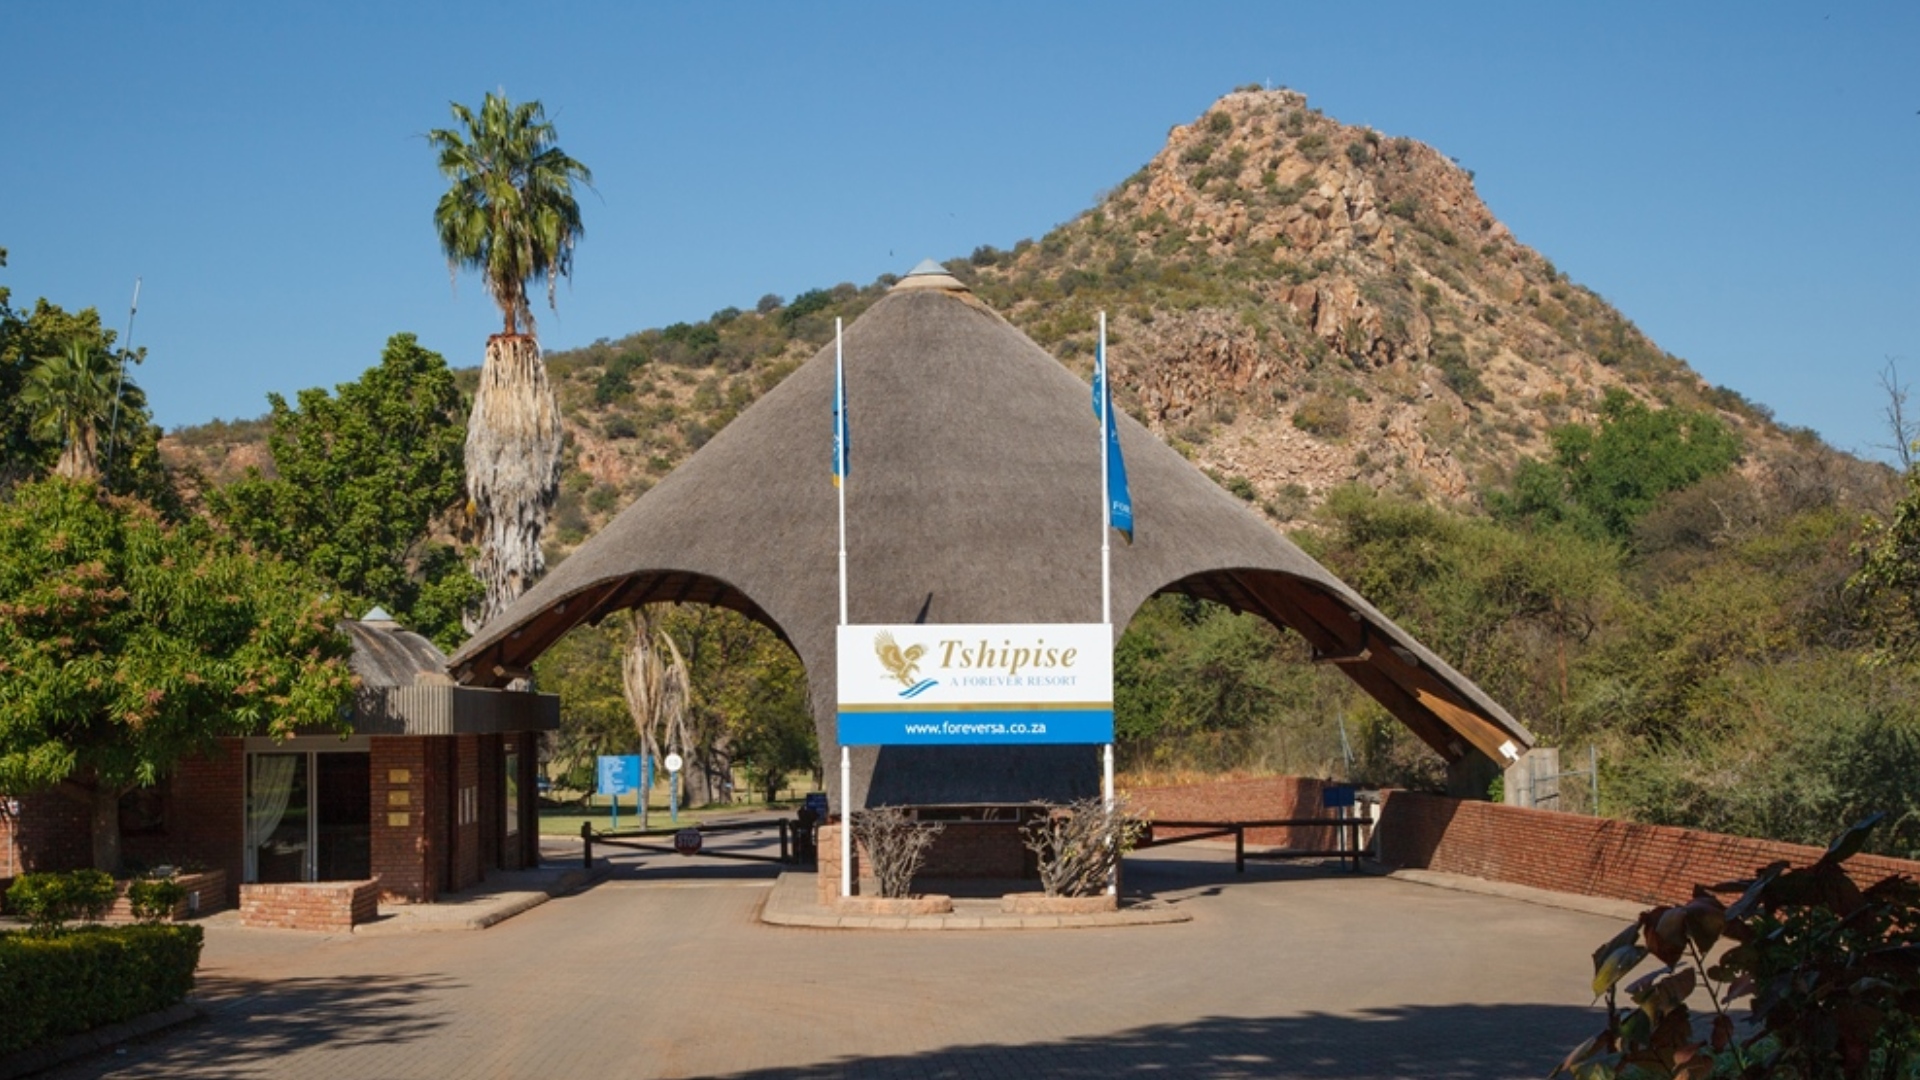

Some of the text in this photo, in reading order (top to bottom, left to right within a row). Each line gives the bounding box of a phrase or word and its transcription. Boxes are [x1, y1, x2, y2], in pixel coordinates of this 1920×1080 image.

[939, 639, 1077, 675] Tshipise
[950, 676, 1077, 686] A FOREVER RESORT
[905, 721, 1047, 735] www.foreversa.co.za
[677, 835, 699, 848] STOP
